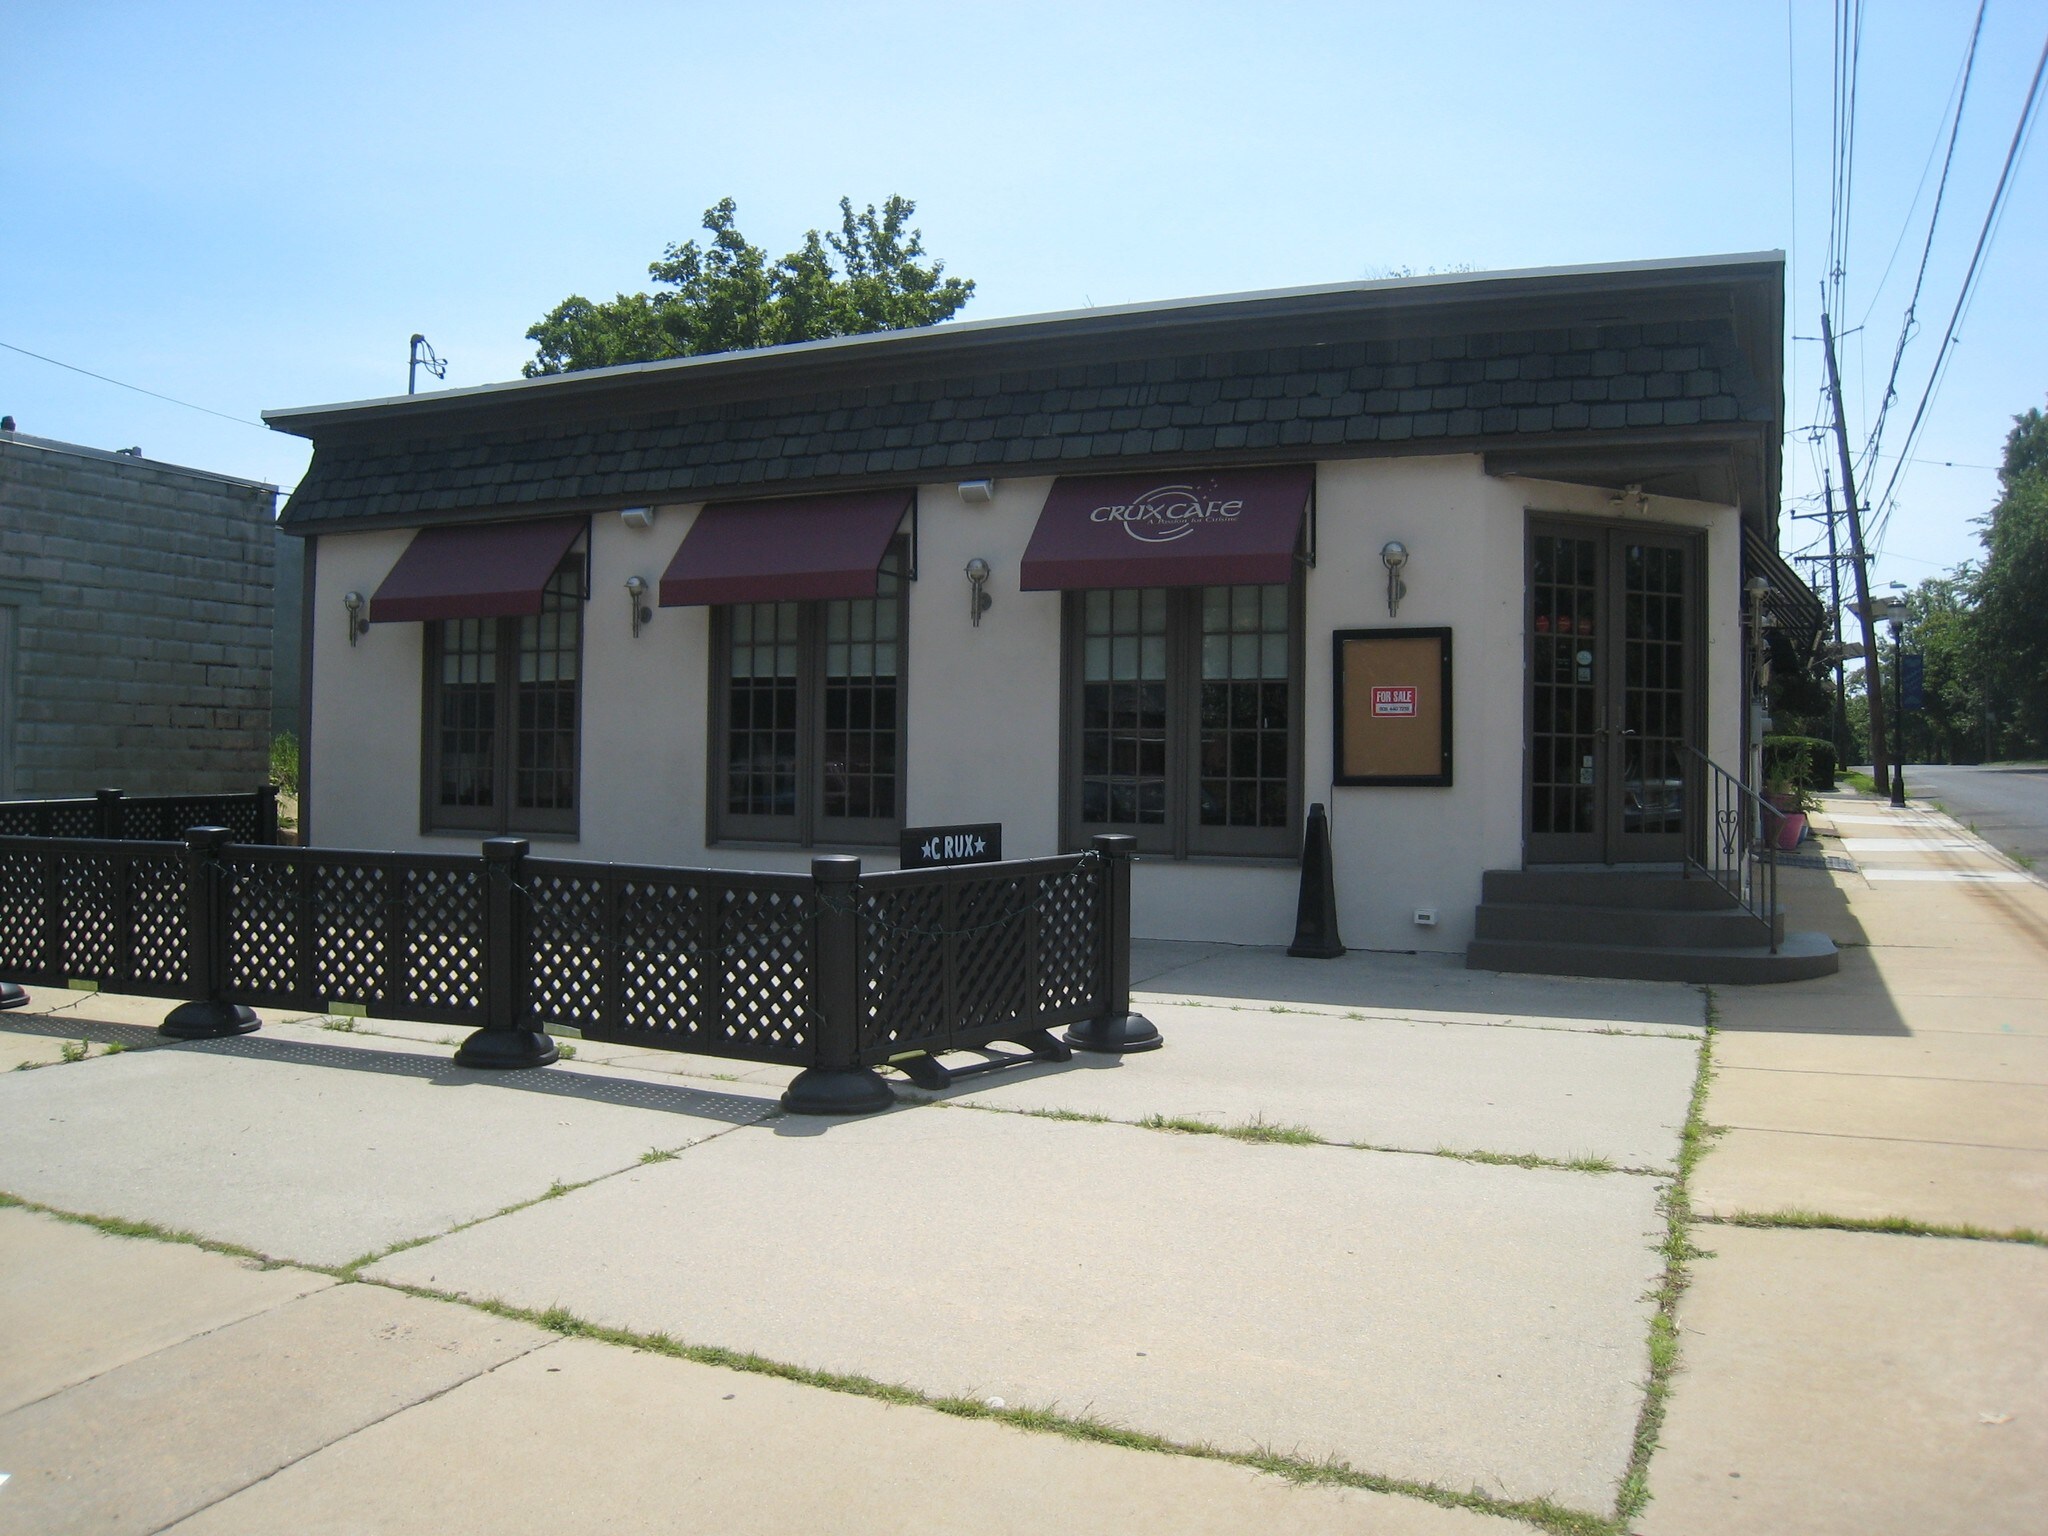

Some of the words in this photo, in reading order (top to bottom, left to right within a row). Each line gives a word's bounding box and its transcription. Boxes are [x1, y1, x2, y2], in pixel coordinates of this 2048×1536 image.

[1158, 517, 1188, 525] Passion
[1205, 515, 1239, 523] Cuisine
[1376, 690, 1391, 703] FOR
[1393, 690, 1412, 703] SALE
